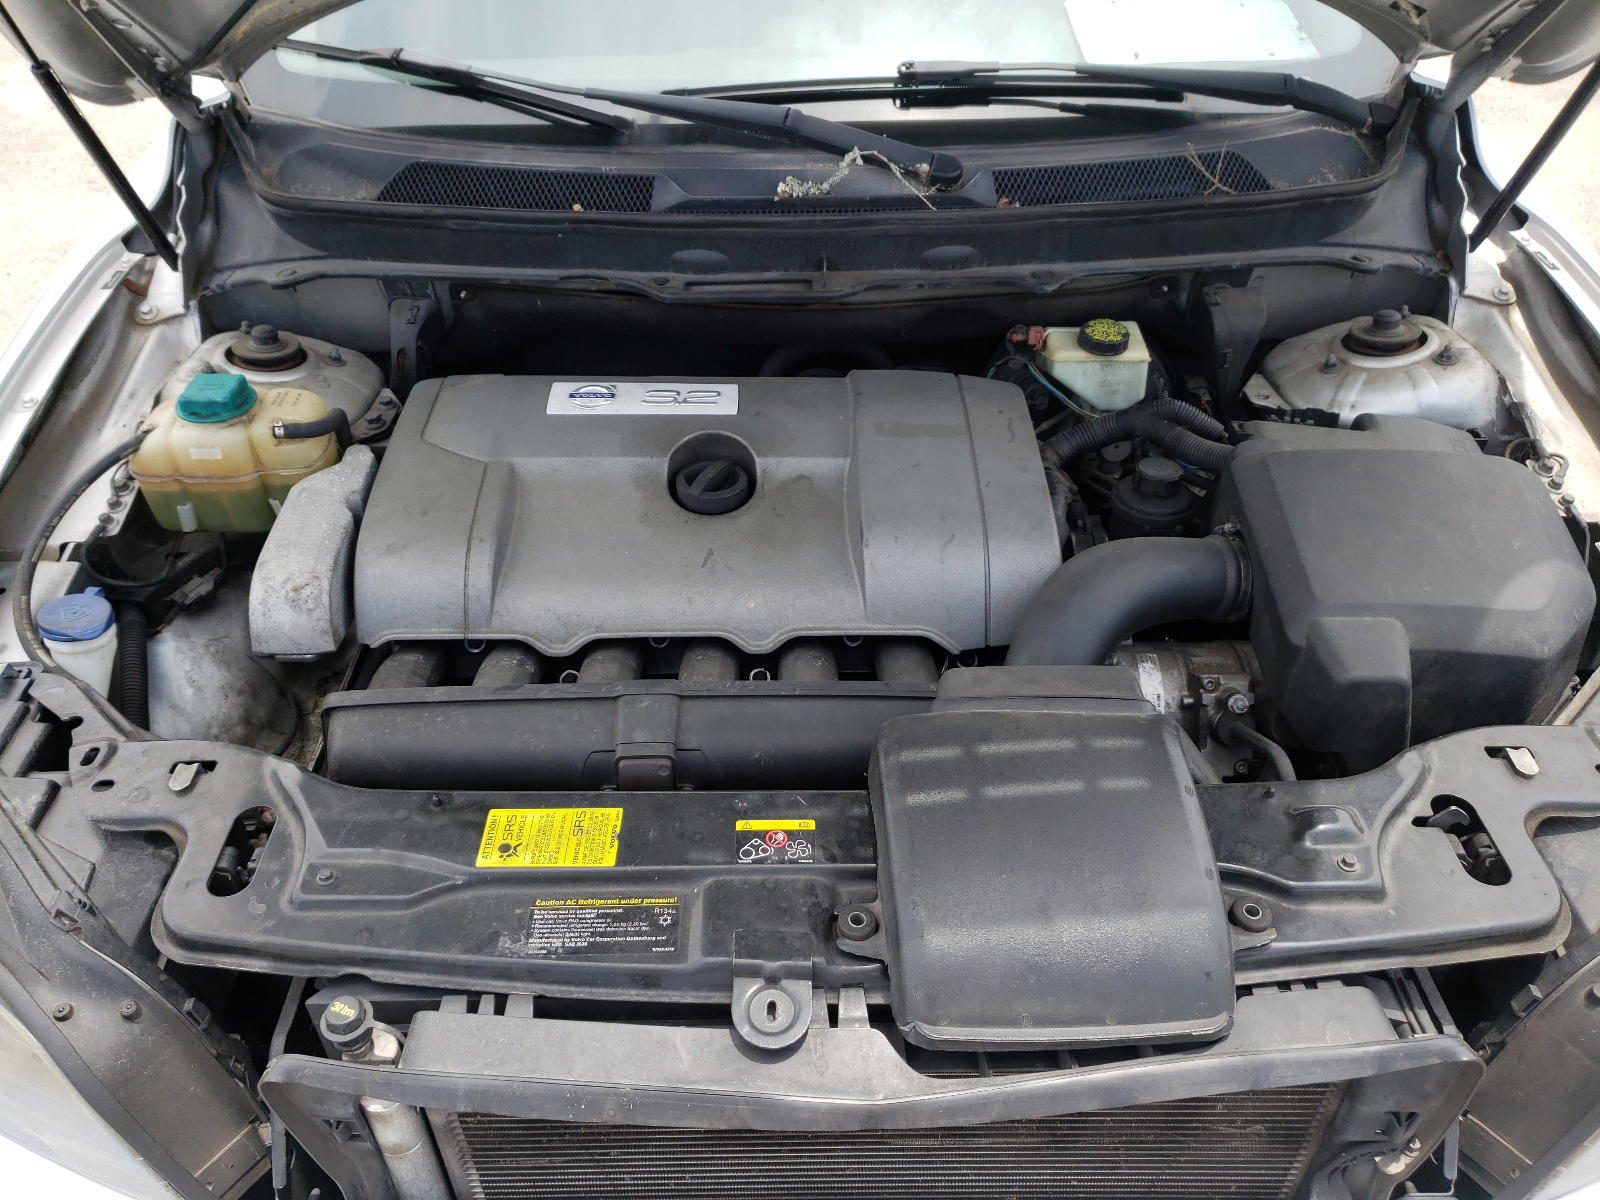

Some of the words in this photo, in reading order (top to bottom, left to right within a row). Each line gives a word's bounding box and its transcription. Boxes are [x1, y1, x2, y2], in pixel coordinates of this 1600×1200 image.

[503, 814, 518, 841] SRS
[515, 815, 528, 841] VEHICLE
[573, 810, 587, 837] SRS
[482, 815, 497, 860] ATTENTION!
[578, 899, 619, 907] Refrigerant
[643, 897, 678, 905] pressure!
